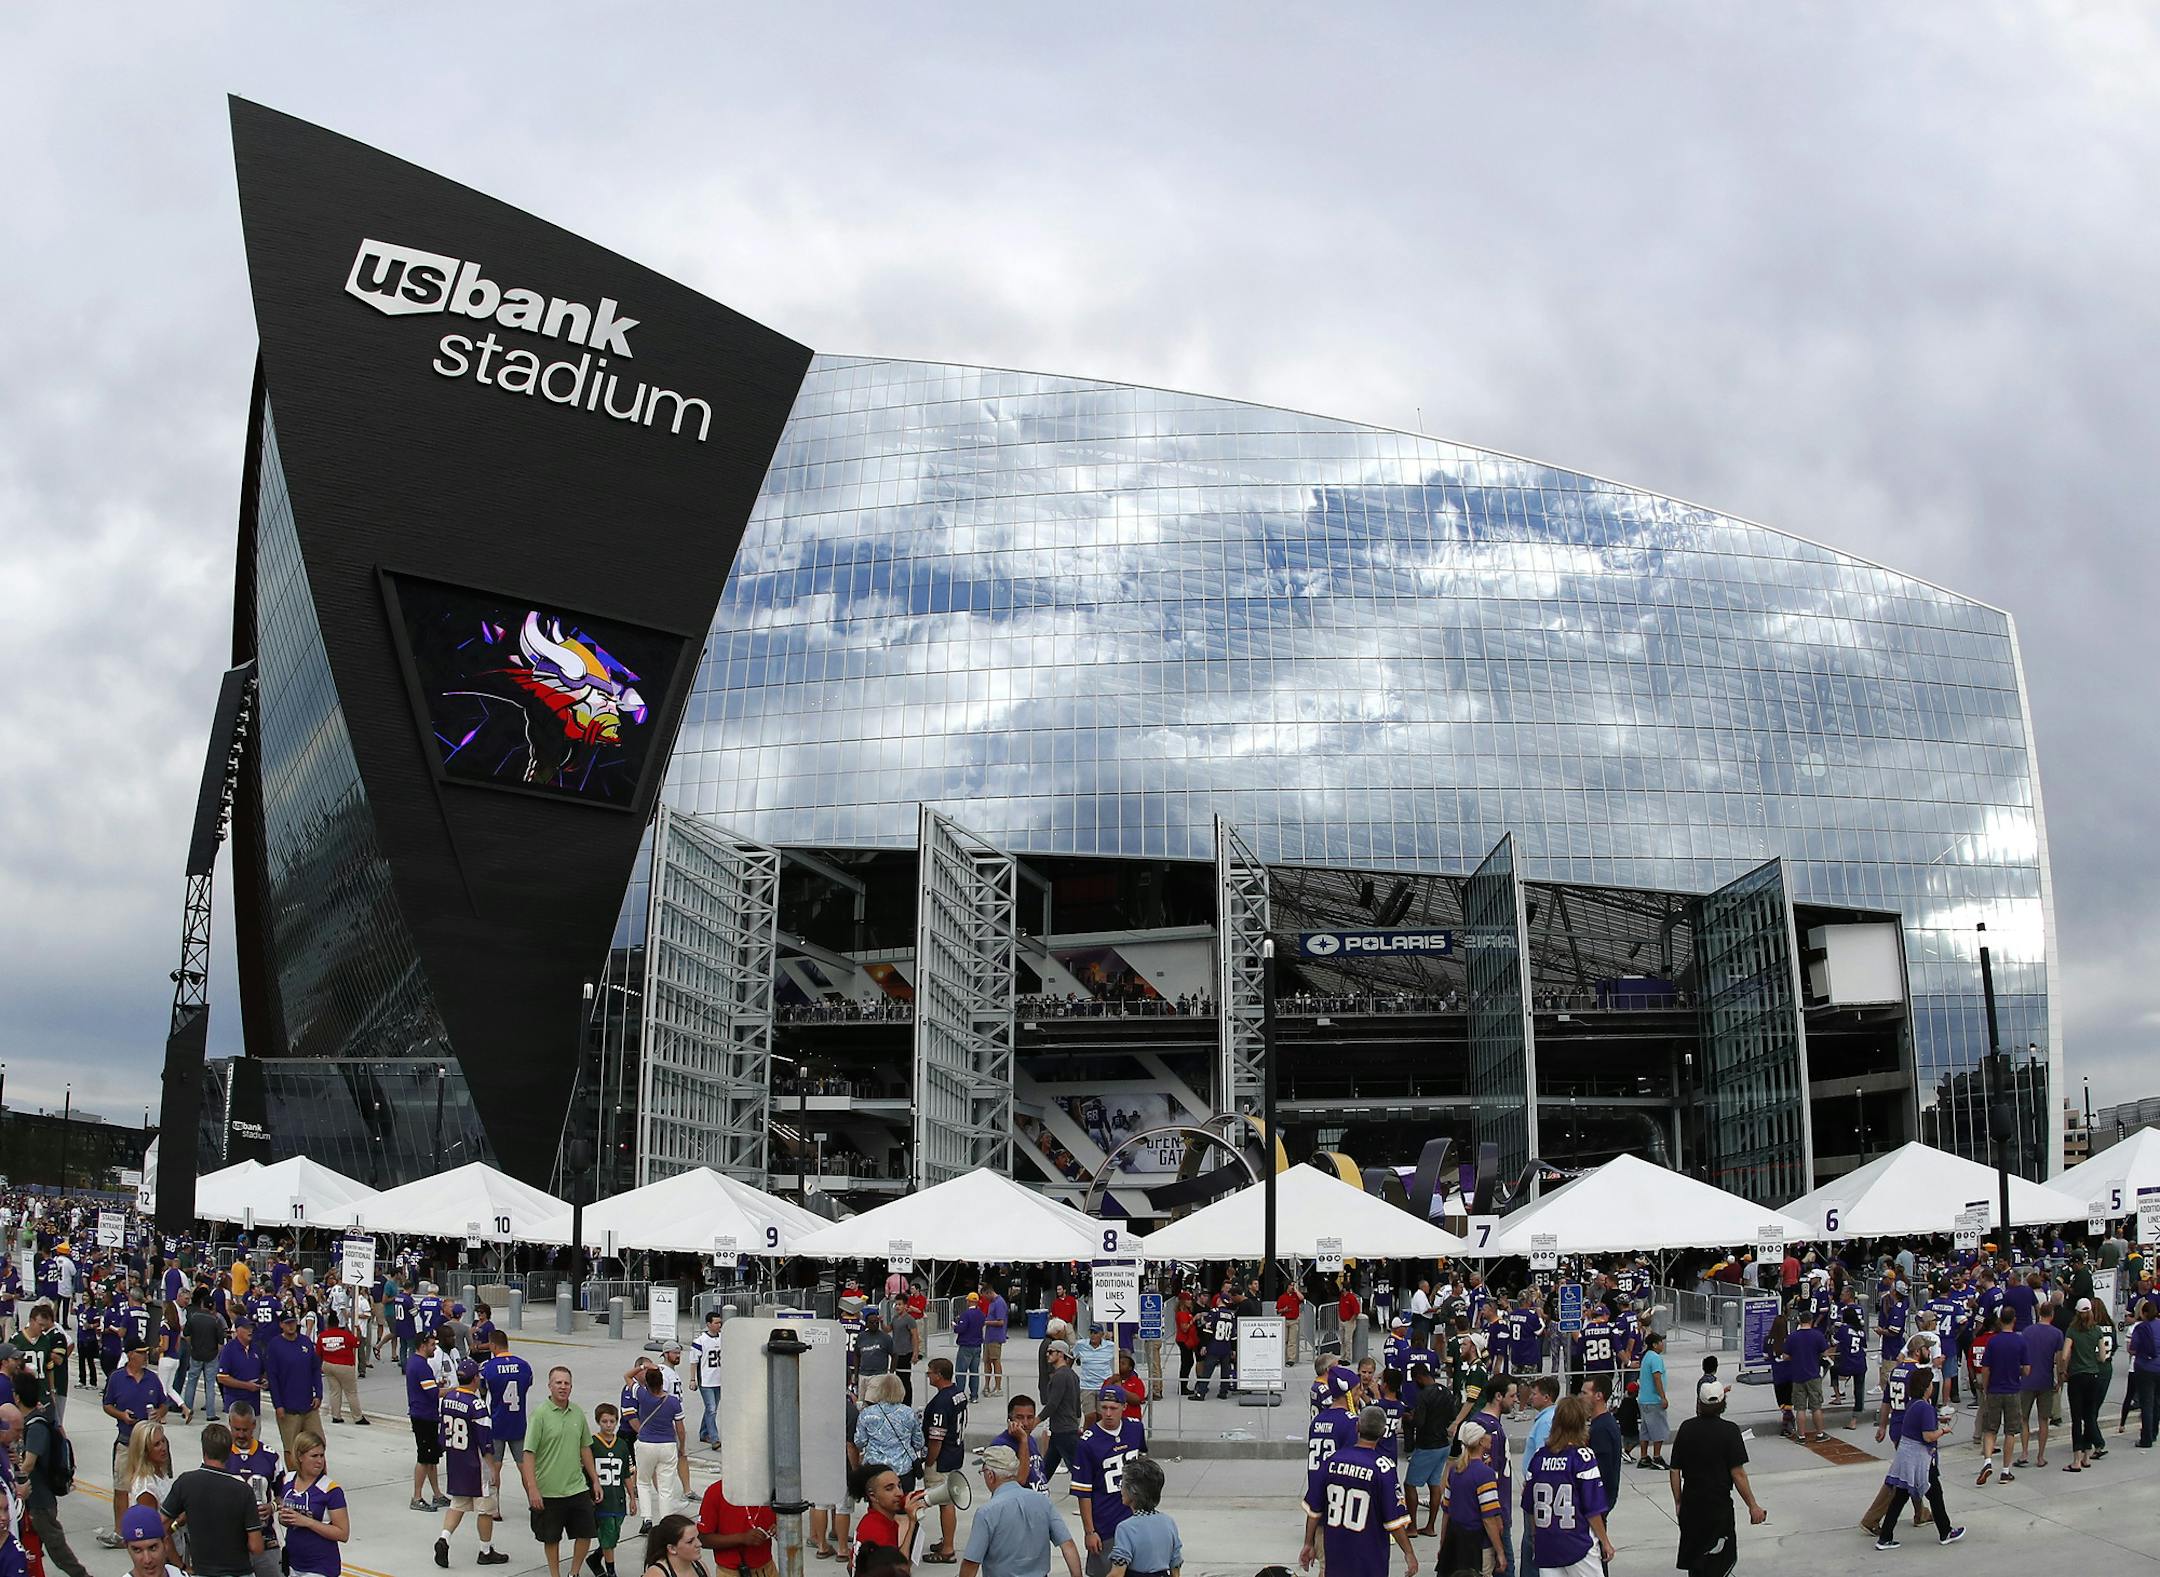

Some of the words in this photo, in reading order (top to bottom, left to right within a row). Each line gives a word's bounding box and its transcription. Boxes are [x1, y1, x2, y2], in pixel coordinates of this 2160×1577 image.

[432, 332, 712, 442] stadium
[1344, 935, 1446, 951] POLARIS
[242, 1131, 271, 1140] stadium
[1159, 1150, 1183, 1166] GAT
[139, 1191, 150, 1206] 12
[2111, 1189, 2121, 1210] 5
[292, 1203, 304, 1219] 11
[2140, 1205, 2160, 1213] ADDITIO
[101, 1214, 122, 1222] STADIUM
[494, 1216, 510, 1233] 10
[1826, 1209, 1839, 1232] 6
[99, 1222, 123, 1231] ENTRANCE
[766, 1227, 778, 1248] 9
[1103, 1229, 1118, 1252] 8
[1476, 1225, 1491, 1248] 7
[345, 1250, 371, 1260] ADDITIONAL
[351, 1261, 365, 1269] LINES
[1095, 1280, 1134, 1288] ADDITIONAL
[1105, 1292, 1125, 1300] LINES
[256, 1307, 272, 1323] 55
[424, 1311, 433, 1327] 7
[1215, 1320, 1233, 1341] 80
[1512, 1324, 1521, 1340] 8
[1585, 1338, 1611, 1361] 28
[1850, 1336, 1861, 1354] 5
[497, 1363, 520, 1374] FAVRE
[502, 1380, 520, 1412] 4
[1889, 1381, 1905, 1411] 52
[933, 1413, 943, 1427] 51
[1313, 1422, 1333, 1433] SMITH
[443, 1414, 468, 1450] 28
[1309, 1438, 1336, 1471] 22
[594, 1457, 623, 1487] 52
[1102, 1449, 1139, 1494] 2
[1328, 1462, 1374, 1482] C.CARTER
[1541, 1457, 1567, 1471] MOSS
[1326, 1483, 1371, 1533] 80
[1533, 1482, 1576, 1529] 84
